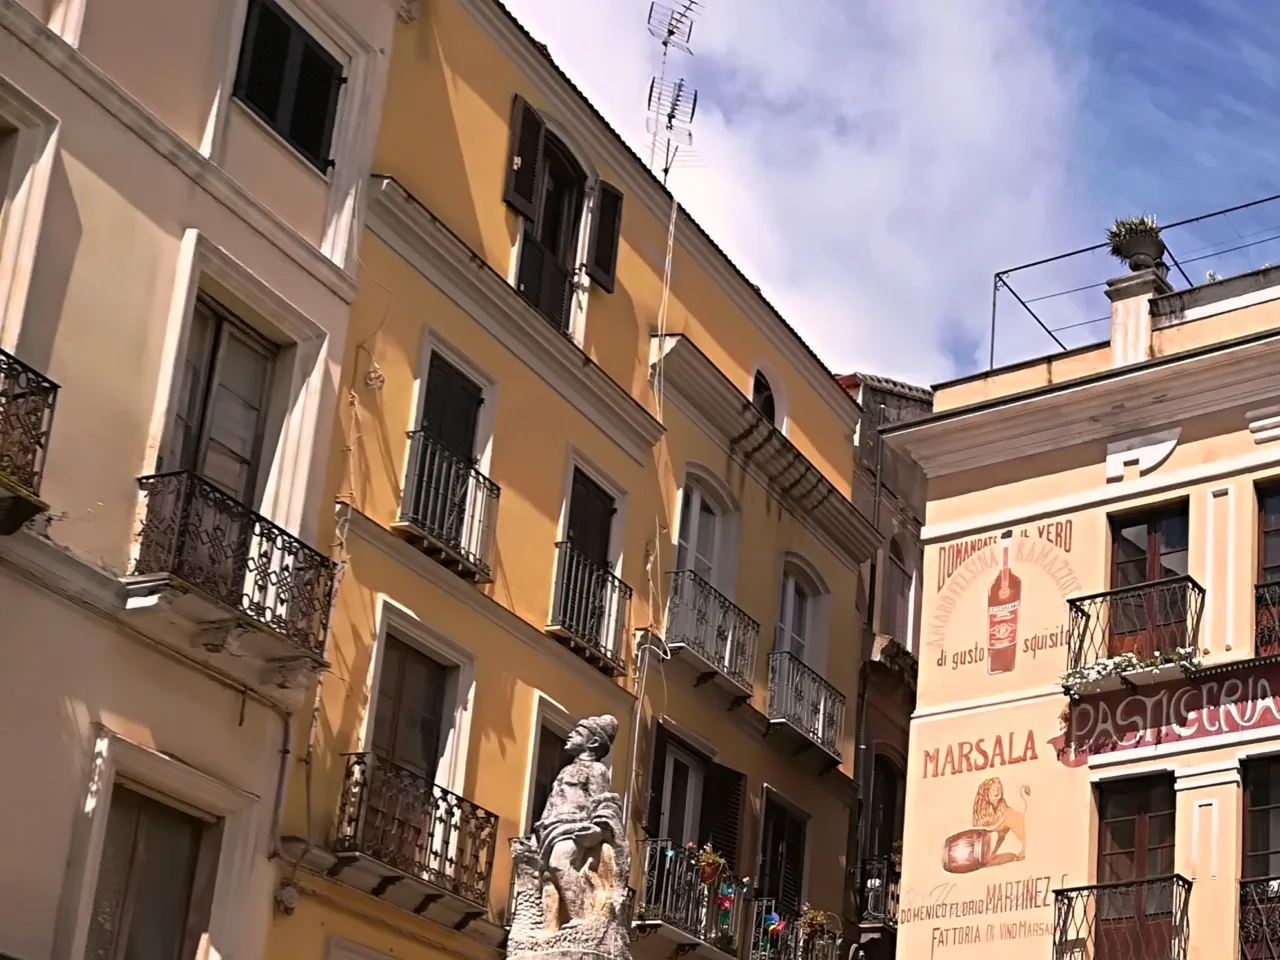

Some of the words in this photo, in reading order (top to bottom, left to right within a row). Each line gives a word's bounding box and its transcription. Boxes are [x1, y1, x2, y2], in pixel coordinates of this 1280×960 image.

[936, 535, 998, 594] DOMANDATE
[1020, 528, 1030, 539] IL
[1037, 518, 1074, 553] VERO
[936, 648, 948, 667] di
[951, 640, 986, 671] gusto
[922, 729, 1039, 779] MARSALA
[900, 902, 948, 925] DOMENICO
[949, 898, 984, 919] FLORIO
